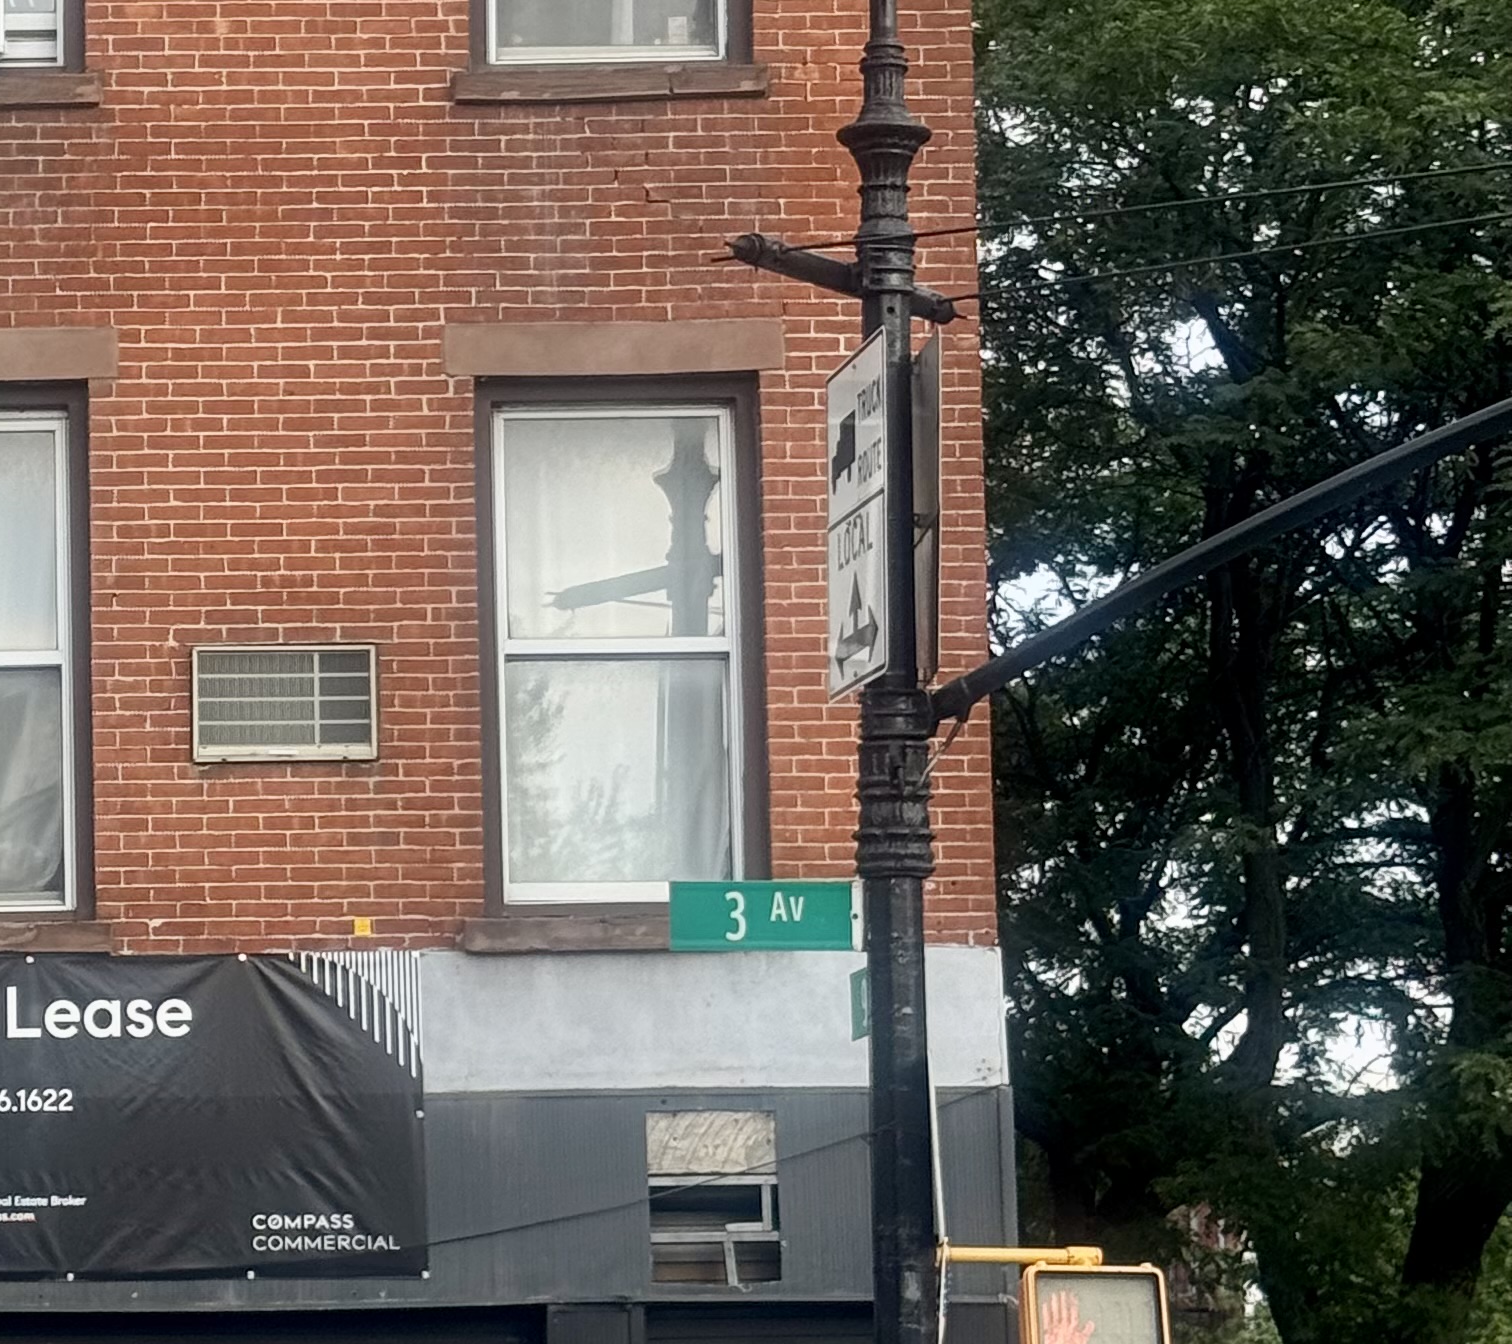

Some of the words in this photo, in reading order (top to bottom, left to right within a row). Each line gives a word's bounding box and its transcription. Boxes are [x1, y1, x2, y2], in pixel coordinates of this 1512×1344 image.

[857, 374, 881, 424] TRUCK
[857, 436, 882, 487] ROUTE
[838, 511, 873, 571] LOCAL
[724, 891, 747, 941] 3
[769, 891, 805, 922] Av
[6, 986, 193, 1039] Lease
[14, 1196, 48, 1207] Estate
[50, 1195, 87, 1206] Broker
[252, 1214, 355, 1230] COMPASS
[252, 1234, 401, 1251] COMMERCIAL
